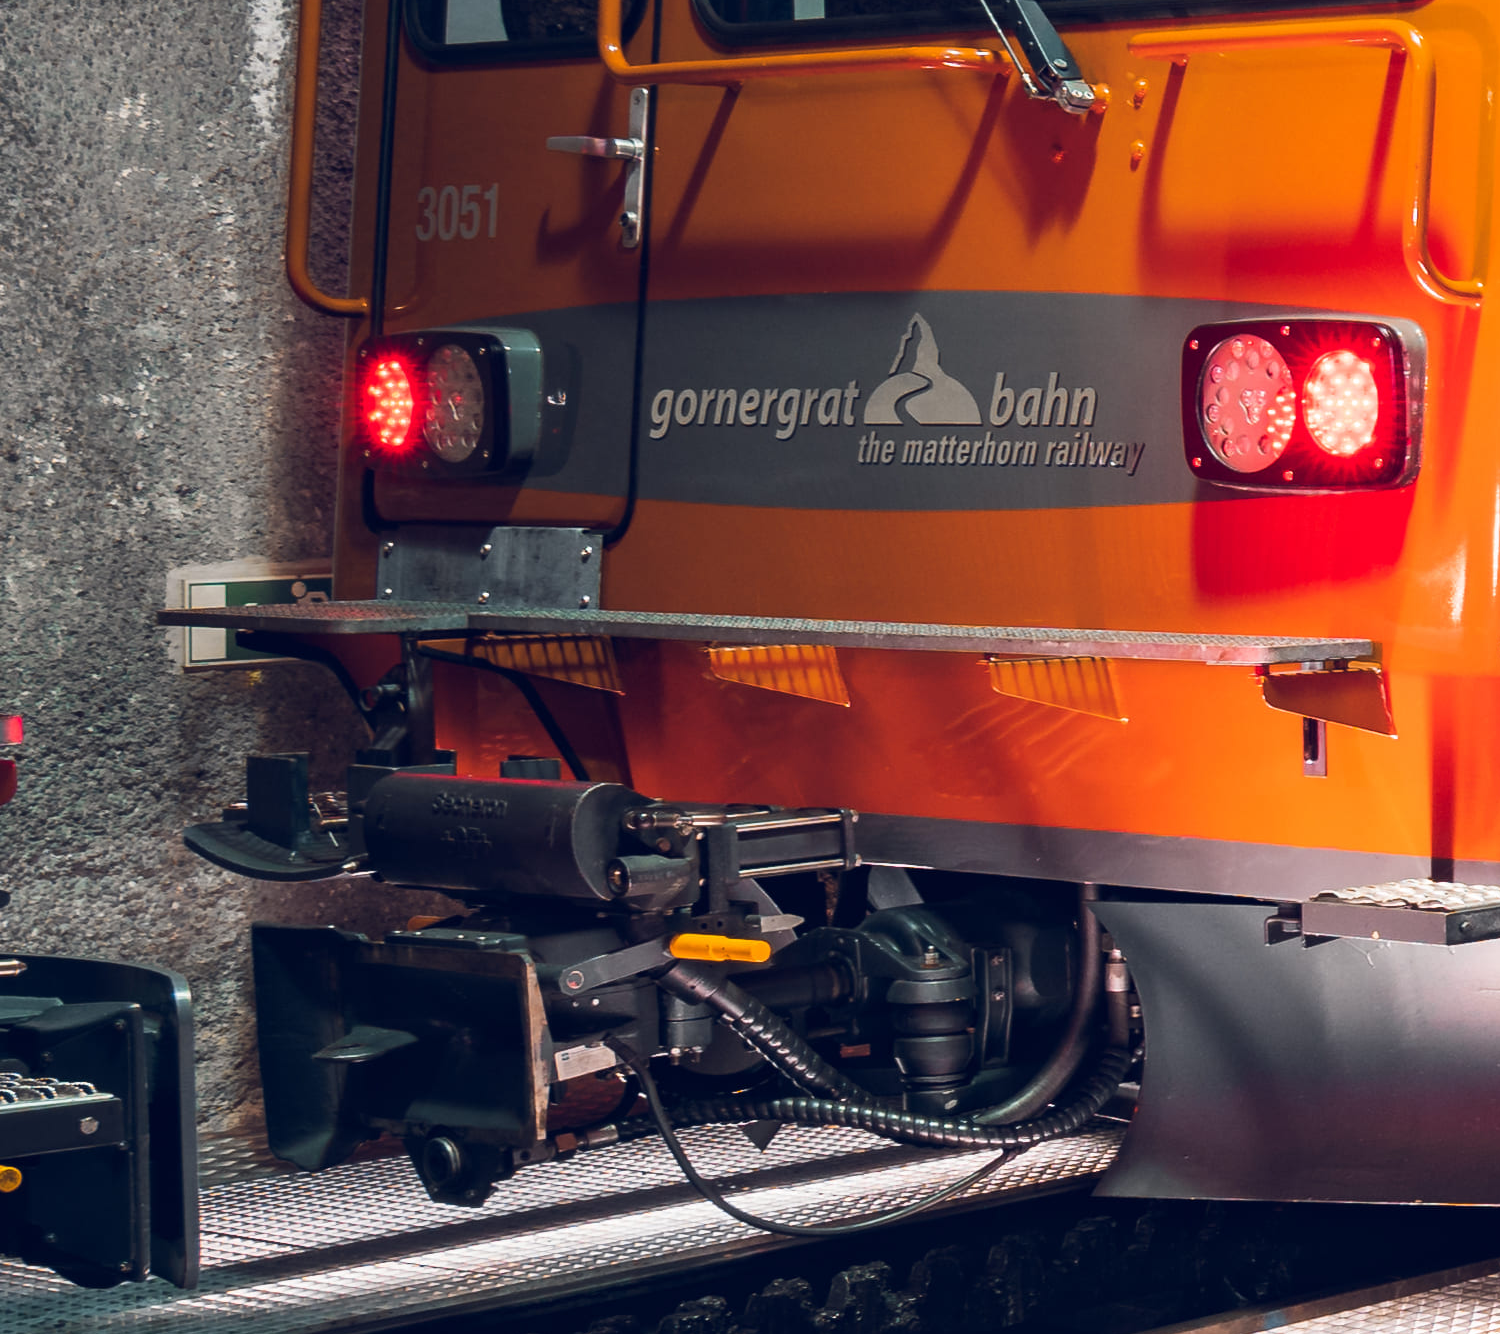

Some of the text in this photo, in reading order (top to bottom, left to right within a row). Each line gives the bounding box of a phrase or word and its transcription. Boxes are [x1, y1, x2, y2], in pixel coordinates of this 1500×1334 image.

[415, 183, 499, 241] 3051
[649, 372, 1097, 440] gornergrat bahn
[857, 431, 1146, 476] the matterhorn railway
